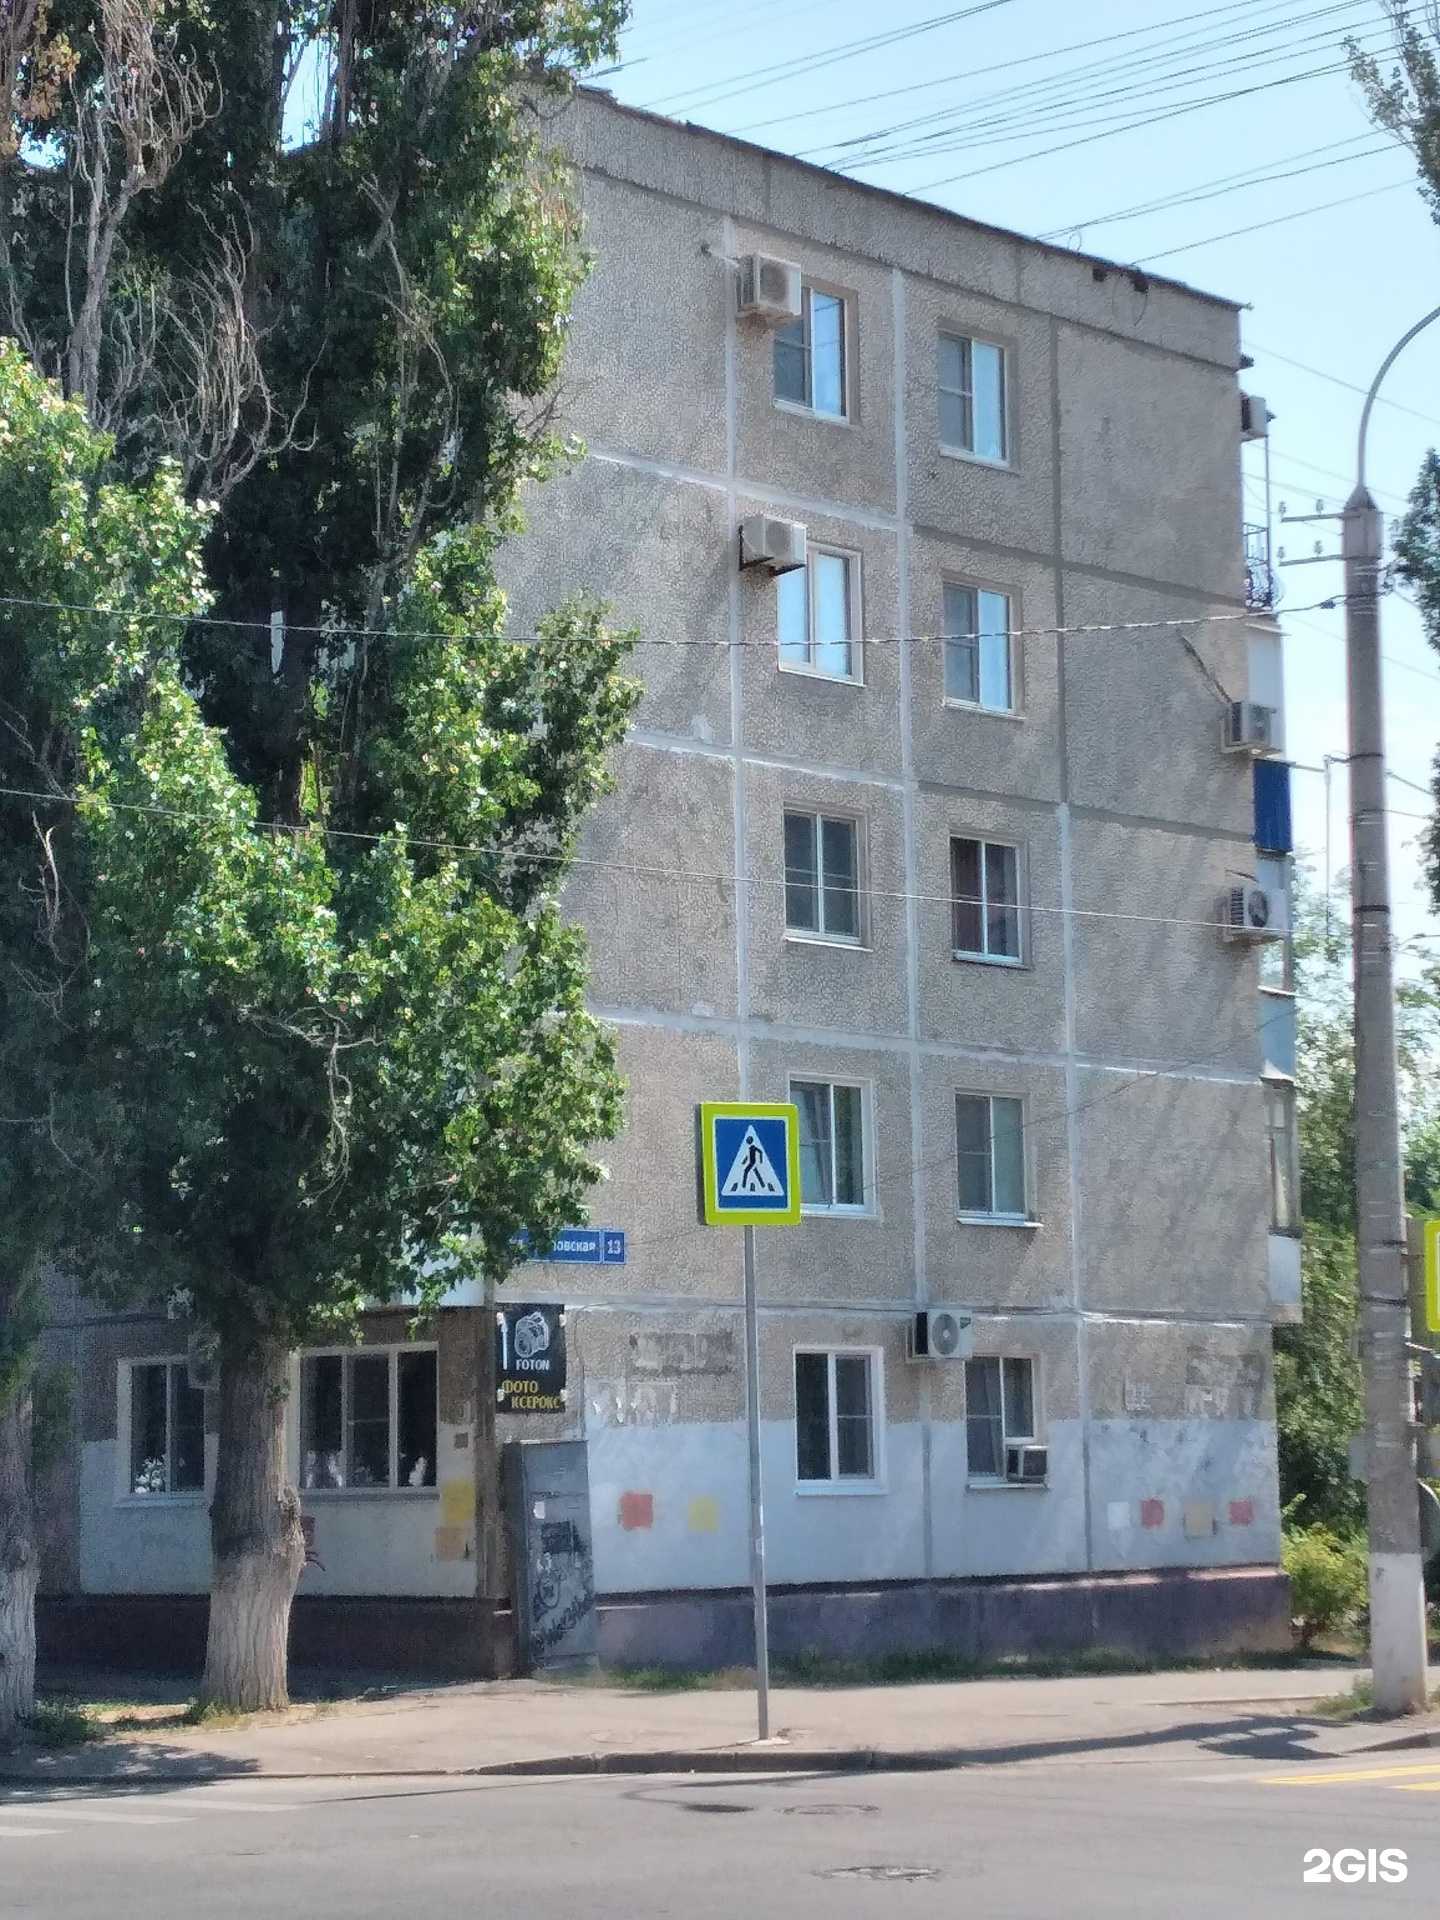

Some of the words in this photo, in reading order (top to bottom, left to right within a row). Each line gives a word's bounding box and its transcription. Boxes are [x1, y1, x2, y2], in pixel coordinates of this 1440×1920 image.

[607, 1240, 621, 1254] 13
[516, 1359, 550, 1370] FOTON
[502, 1380, 539, 1393] ФОТО
[511, 1396, 561, 1409] КСЕРОКС
